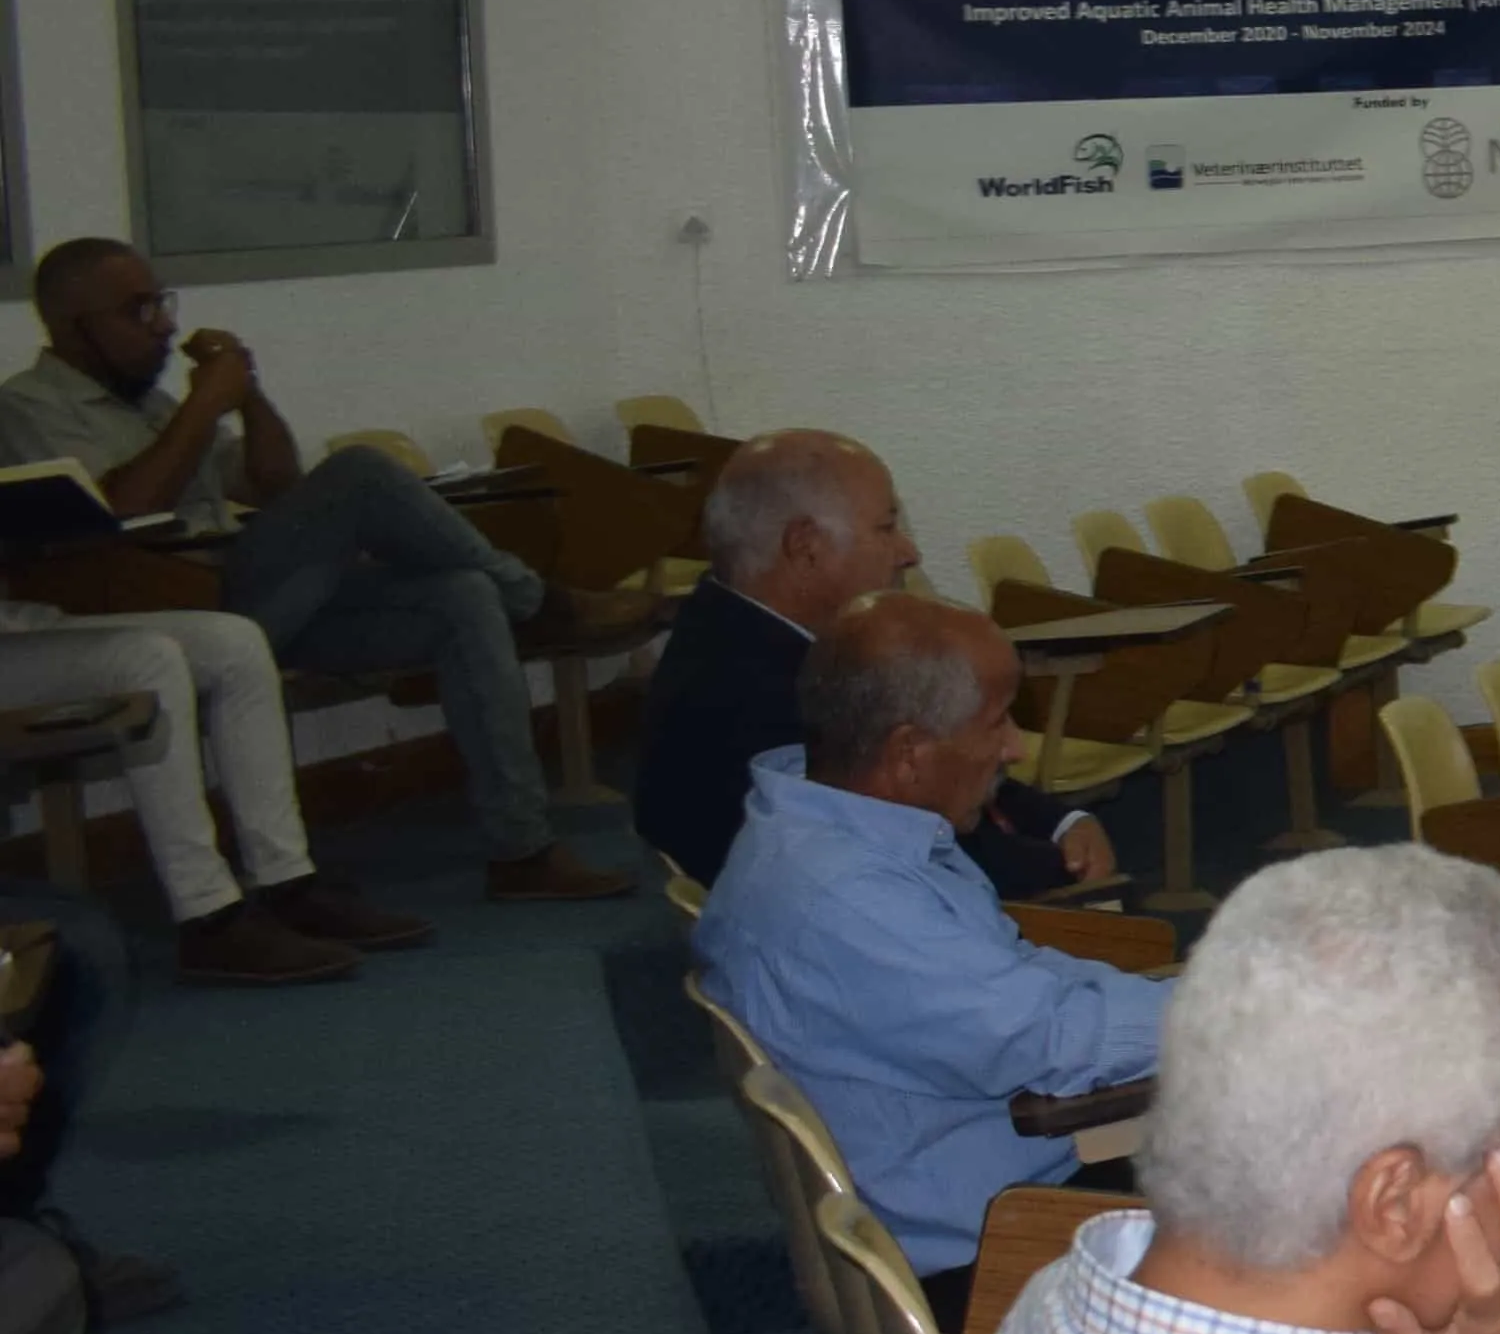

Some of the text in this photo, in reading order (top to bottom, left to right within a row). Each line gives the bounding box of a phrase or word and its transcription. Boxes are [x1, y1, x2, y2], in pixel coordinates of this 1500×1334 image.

[963, 1, 1070, 25] Improved
[1076, 0, 1161, 24] Aquatic
[1140, 28, 1238, 46] December
[1241, 26, 1288, 43] 2020
[1302, 22, 1400, 41] November
[1403, 19, 1447, 37] 2024
[978, 173, 1116, 199] WorldFish
